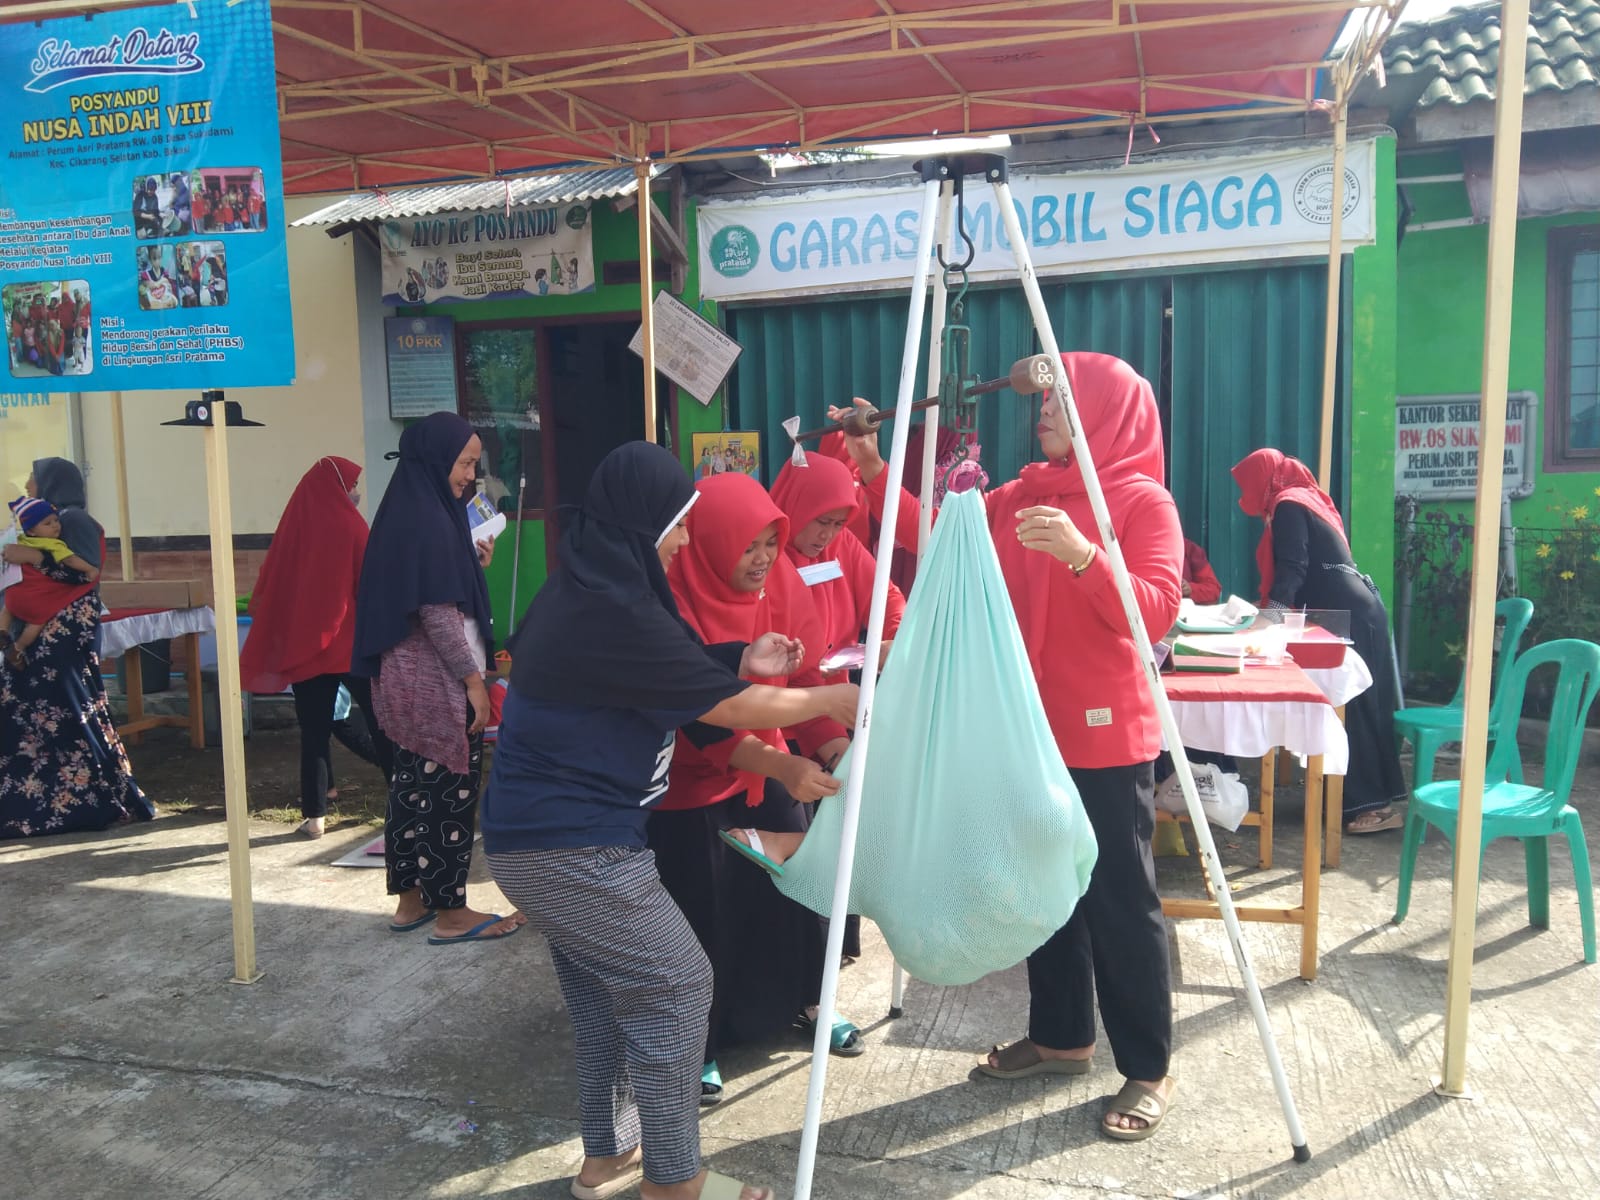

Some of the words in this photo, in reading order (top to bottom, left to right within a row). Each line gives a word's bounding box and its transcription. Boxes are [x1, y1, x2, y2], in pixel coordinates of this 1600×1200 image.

[32, 37, 121, 74] Selamat
[122, 28, 200, 64] Datang
[70, 87, 160, 113] POSYANDU
[23, 115, 84, 143] NUSA
[88, 108, 160, 137] INDAH
[166, 100, 212, 127] VIII
[96, 140, 131, 151] Pratama
[69, 156, 108, 167] Cikarang
[0, 209, 9, 218] isi
[49, 215, 112, 228] keseimbangan
[410, 219, 445, 247] AYO
[448, 217, 469, 244] Ke
[474, 207, 558, 242] POSYANDU
[769, 210, 936, 272] GARAS
[955, 191, 1108, 254] MOBIL
[1124, 172, 1282, 238] SIAGA
[42, 231, 72, 240] antara
[75, 229, 89, 238] Ibu
[92, 229, 107, 238] dan
[109, 226, 131, 236] Anak
[31, 245, 69, 255] Kegiatan
[0, 259, 41, 271] Posyandu
[44, 258, 64, 267] Nusa
[66, 255, 91, 265] Indah
[94, 253, 112, 263] VIII
[456, 264, 476, 274] Ibu
[479, 260, 523, 271] Senang
[452, 274, 482, 286] Kami
[484, 270, 530, 282] Bangga
[463, 284, 487, 295] Jadi
[487, 281, 525, 293] Kader
[101, 317, 119, 327] Misi
[101, 330, 150, 341] Mendorong
[152, 328, 187, 339] gerakan
[189, 325, 230, 336] Perilaku
[102, 342, 129, 354] Hidup
[130, 341, 157, 352] Bersih
[159, 340, 174, 350] dan
[176, 338, 202, 349] Sehat
[205, 337, 244, 350] (PHBS)
[397, 335, 414, 349] 10
[102, 355, 111, 366] di
[114, 354, 164, 367] Lingkungan
[165, 352, 182, 363] Asri
[185, 351, 225, 362] Pratama
[1400, 407, 1445, 424] KANTOR
[1400, 427, 1447, 449] RW.08
